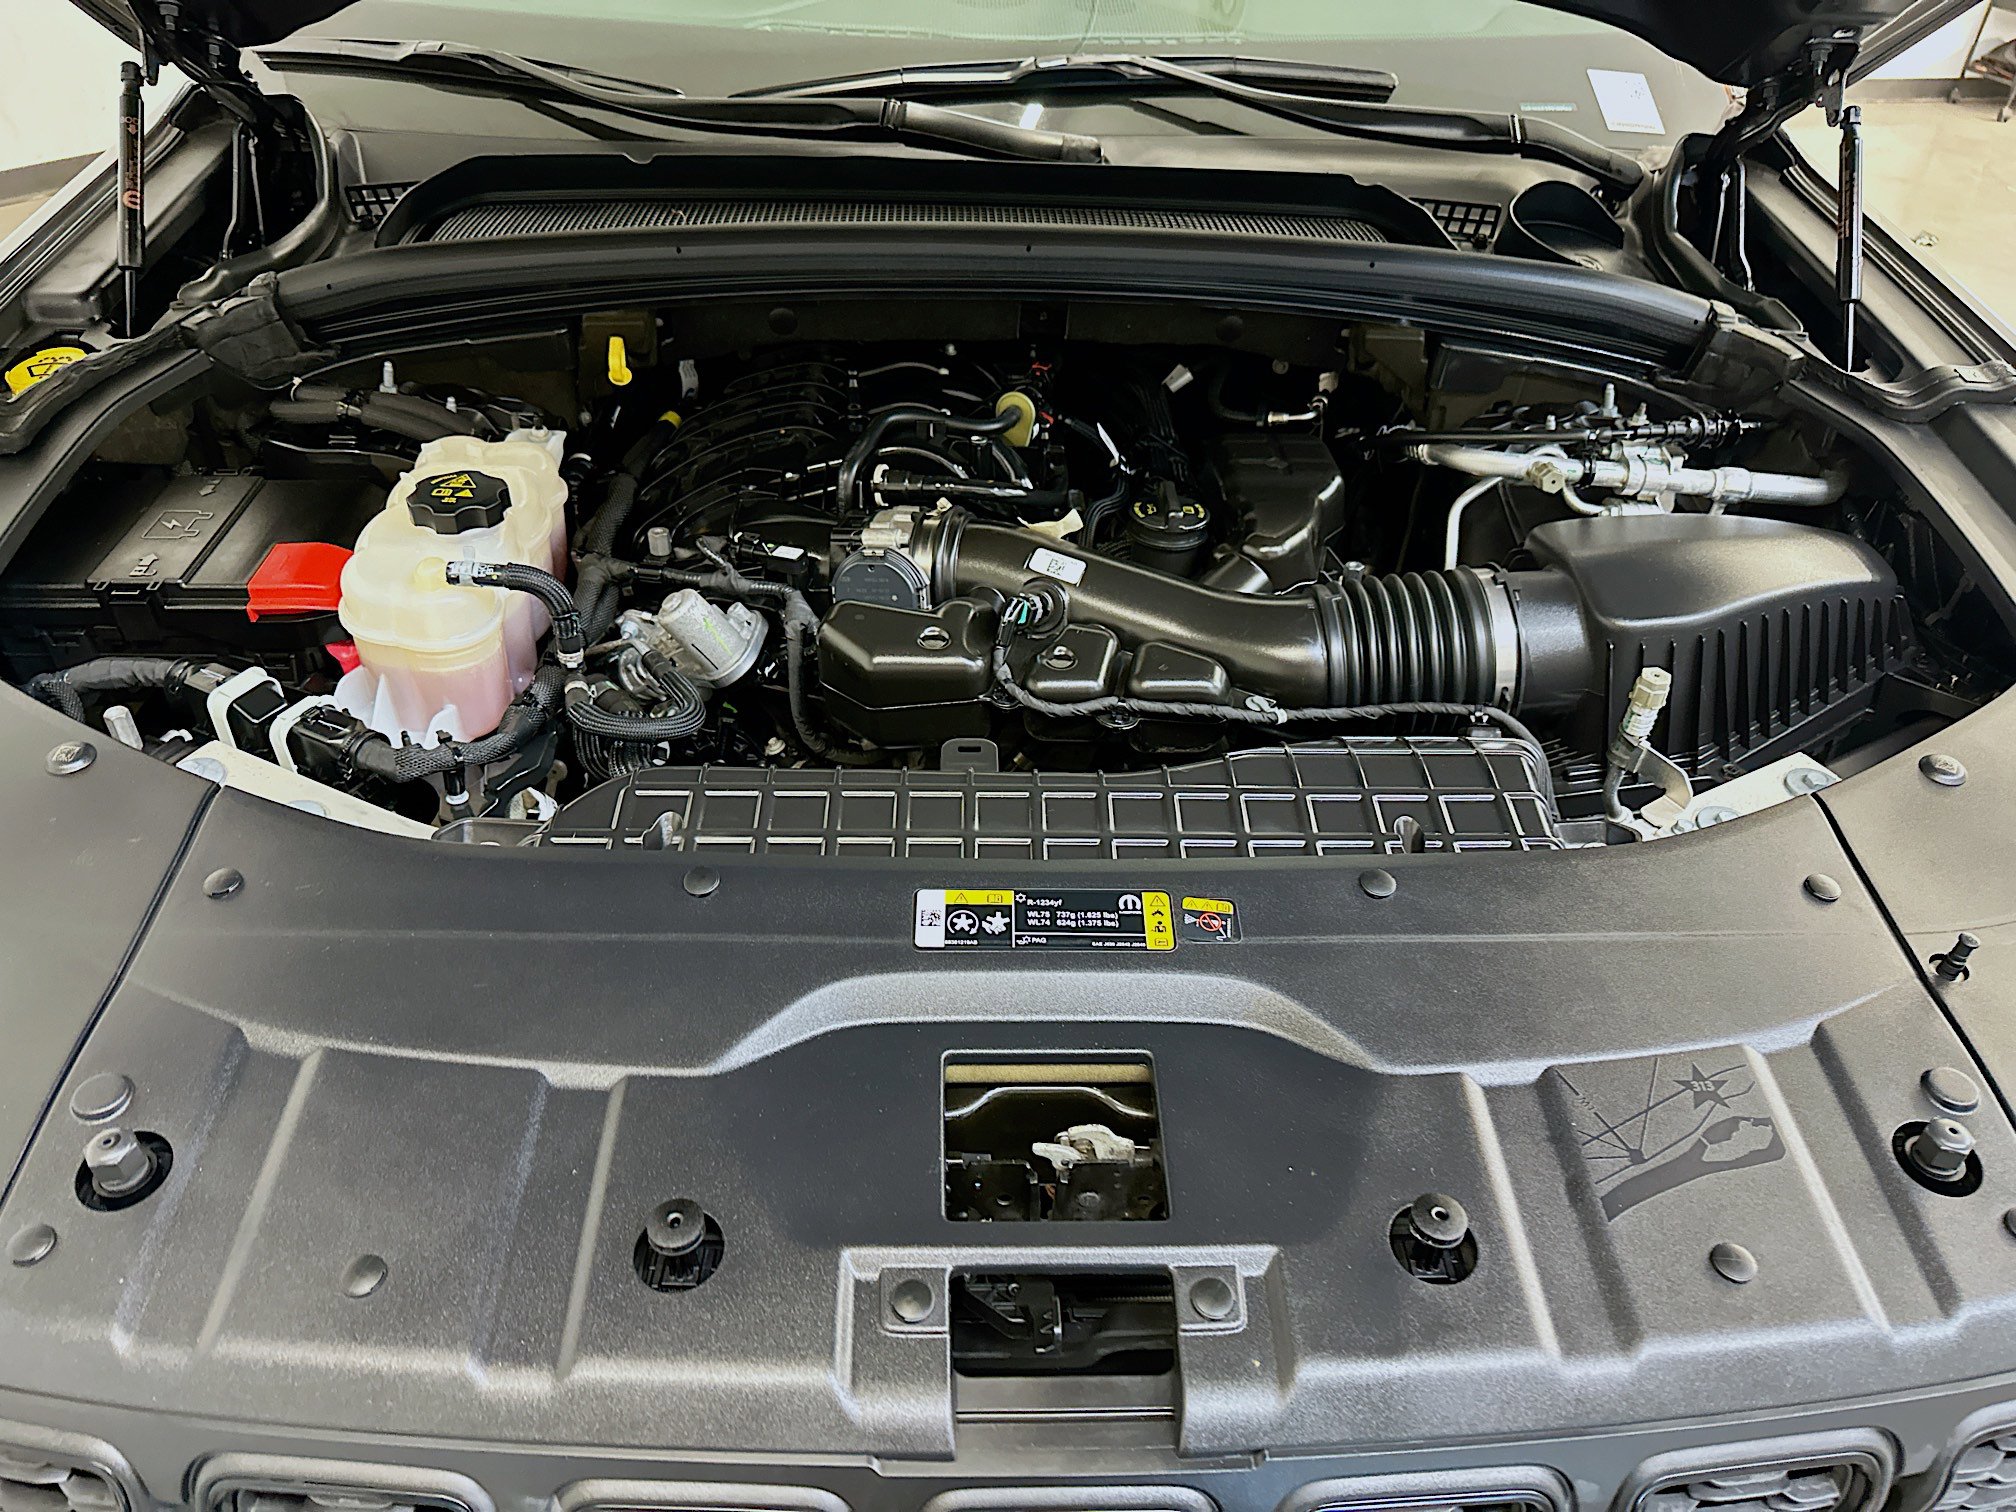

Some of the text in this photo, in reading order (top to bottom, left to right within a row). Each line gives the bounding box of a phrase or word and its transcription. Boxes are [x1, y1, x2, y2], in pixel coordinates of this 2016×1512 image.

[1027, 898, 1062, 907] R-1234yf
[1027, 910, 1050, 918] WL75
[1056, 911, 1076, 919] 737g
[1103, 911, 1118, 919] lbs)
[1027, 918, 1119, 928] WL74 624g (1.375 lbs)
[1690, 1081, 1715, 1092] 313
